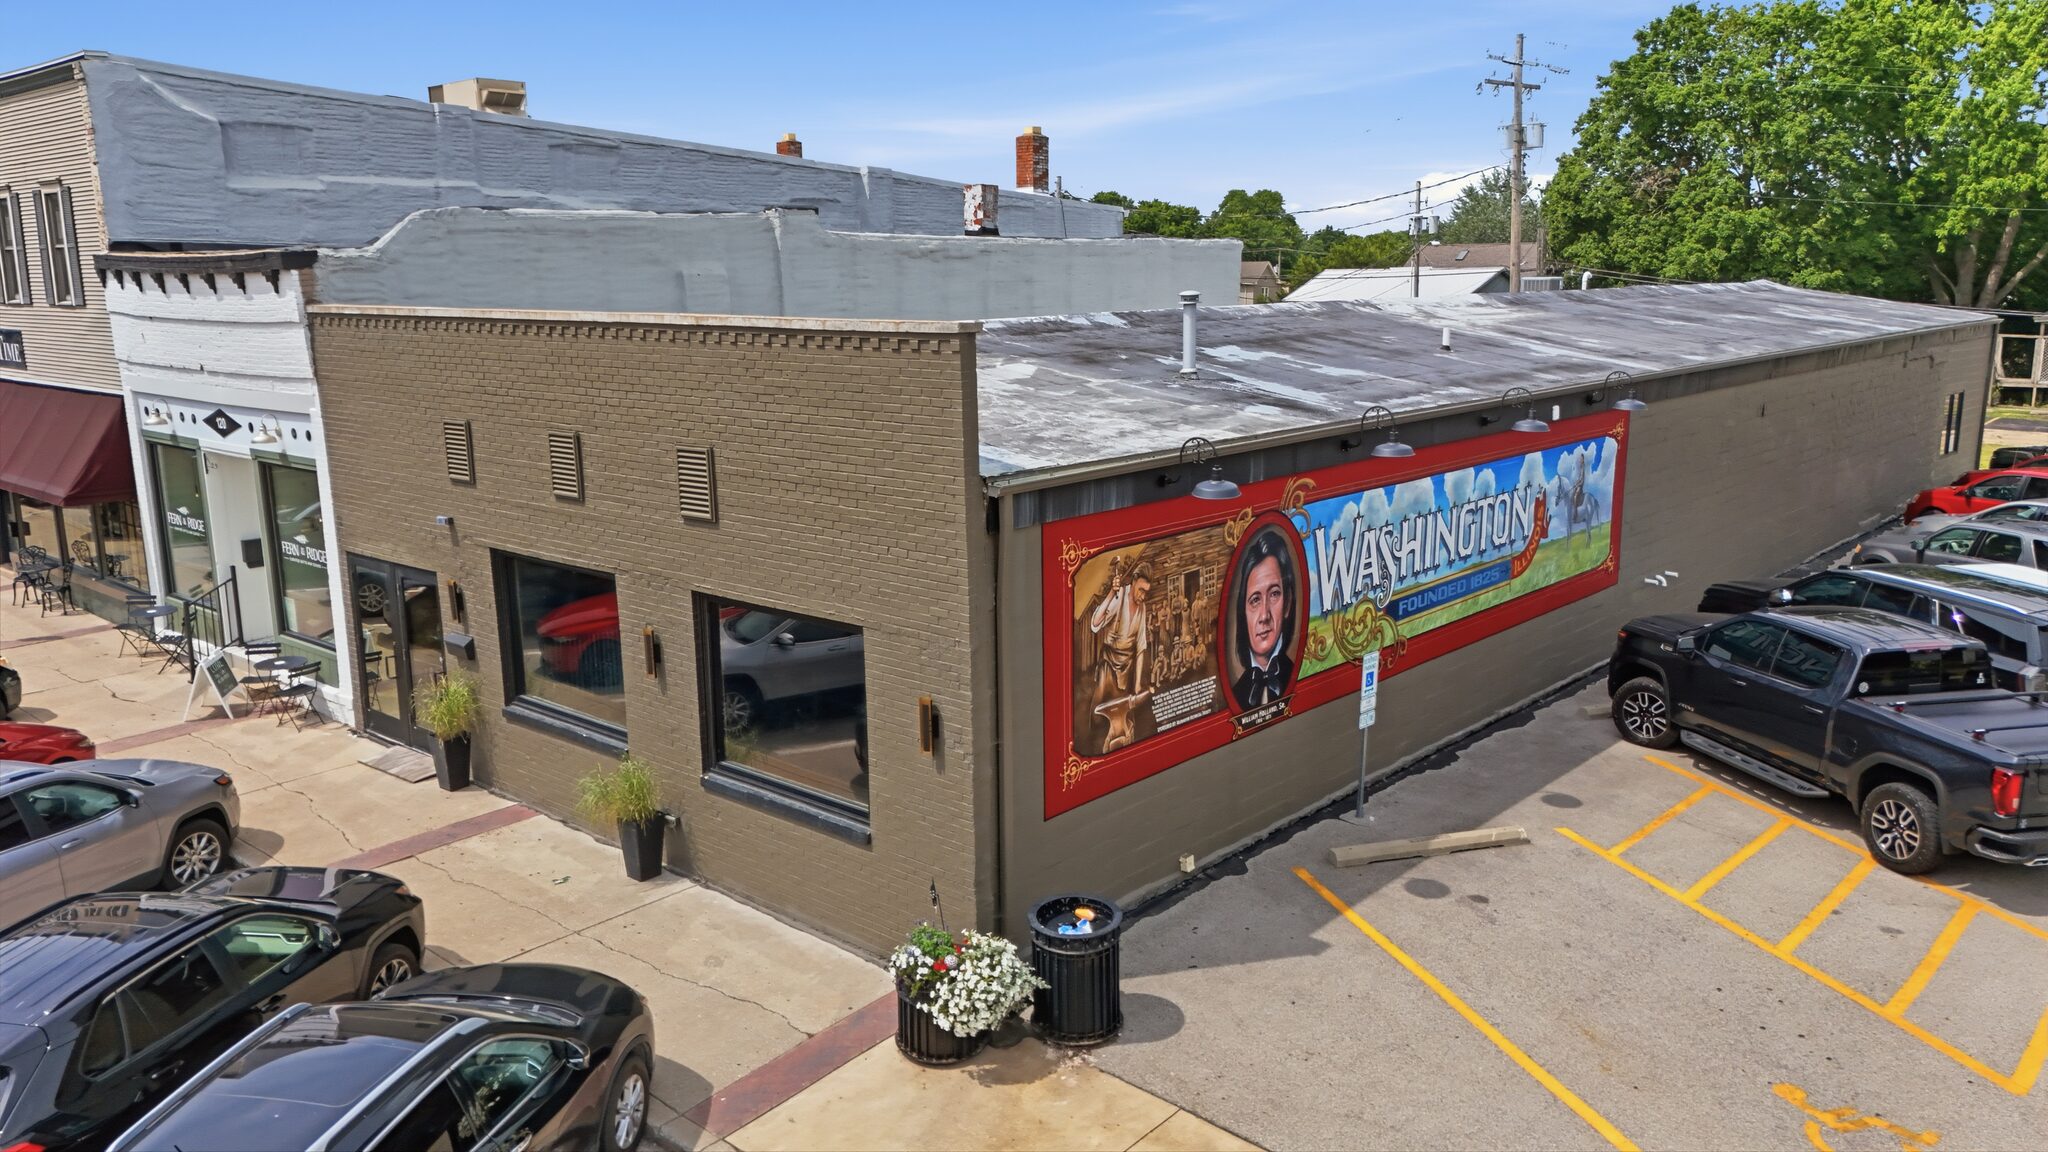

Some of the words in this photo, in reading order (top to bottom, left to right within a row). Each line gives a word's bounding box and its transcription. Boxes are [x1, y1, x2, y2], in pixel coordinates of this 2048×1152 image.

[0, 336, 22, 362] IME
[167, 511, 182, 526] FERN
[187, 516, 206, 532] RIDGE
[1514, 503, 1544, 576] ILLINOIS
[281, 541, 299, 557] FERN
[306, 546, 328, 564] RIDGE
[1313, 483, 1532, 613] WASHINGTON
[1398, 580, 1466, 616] FOUNDED
[1470, 568, 1501, 590] 1825
